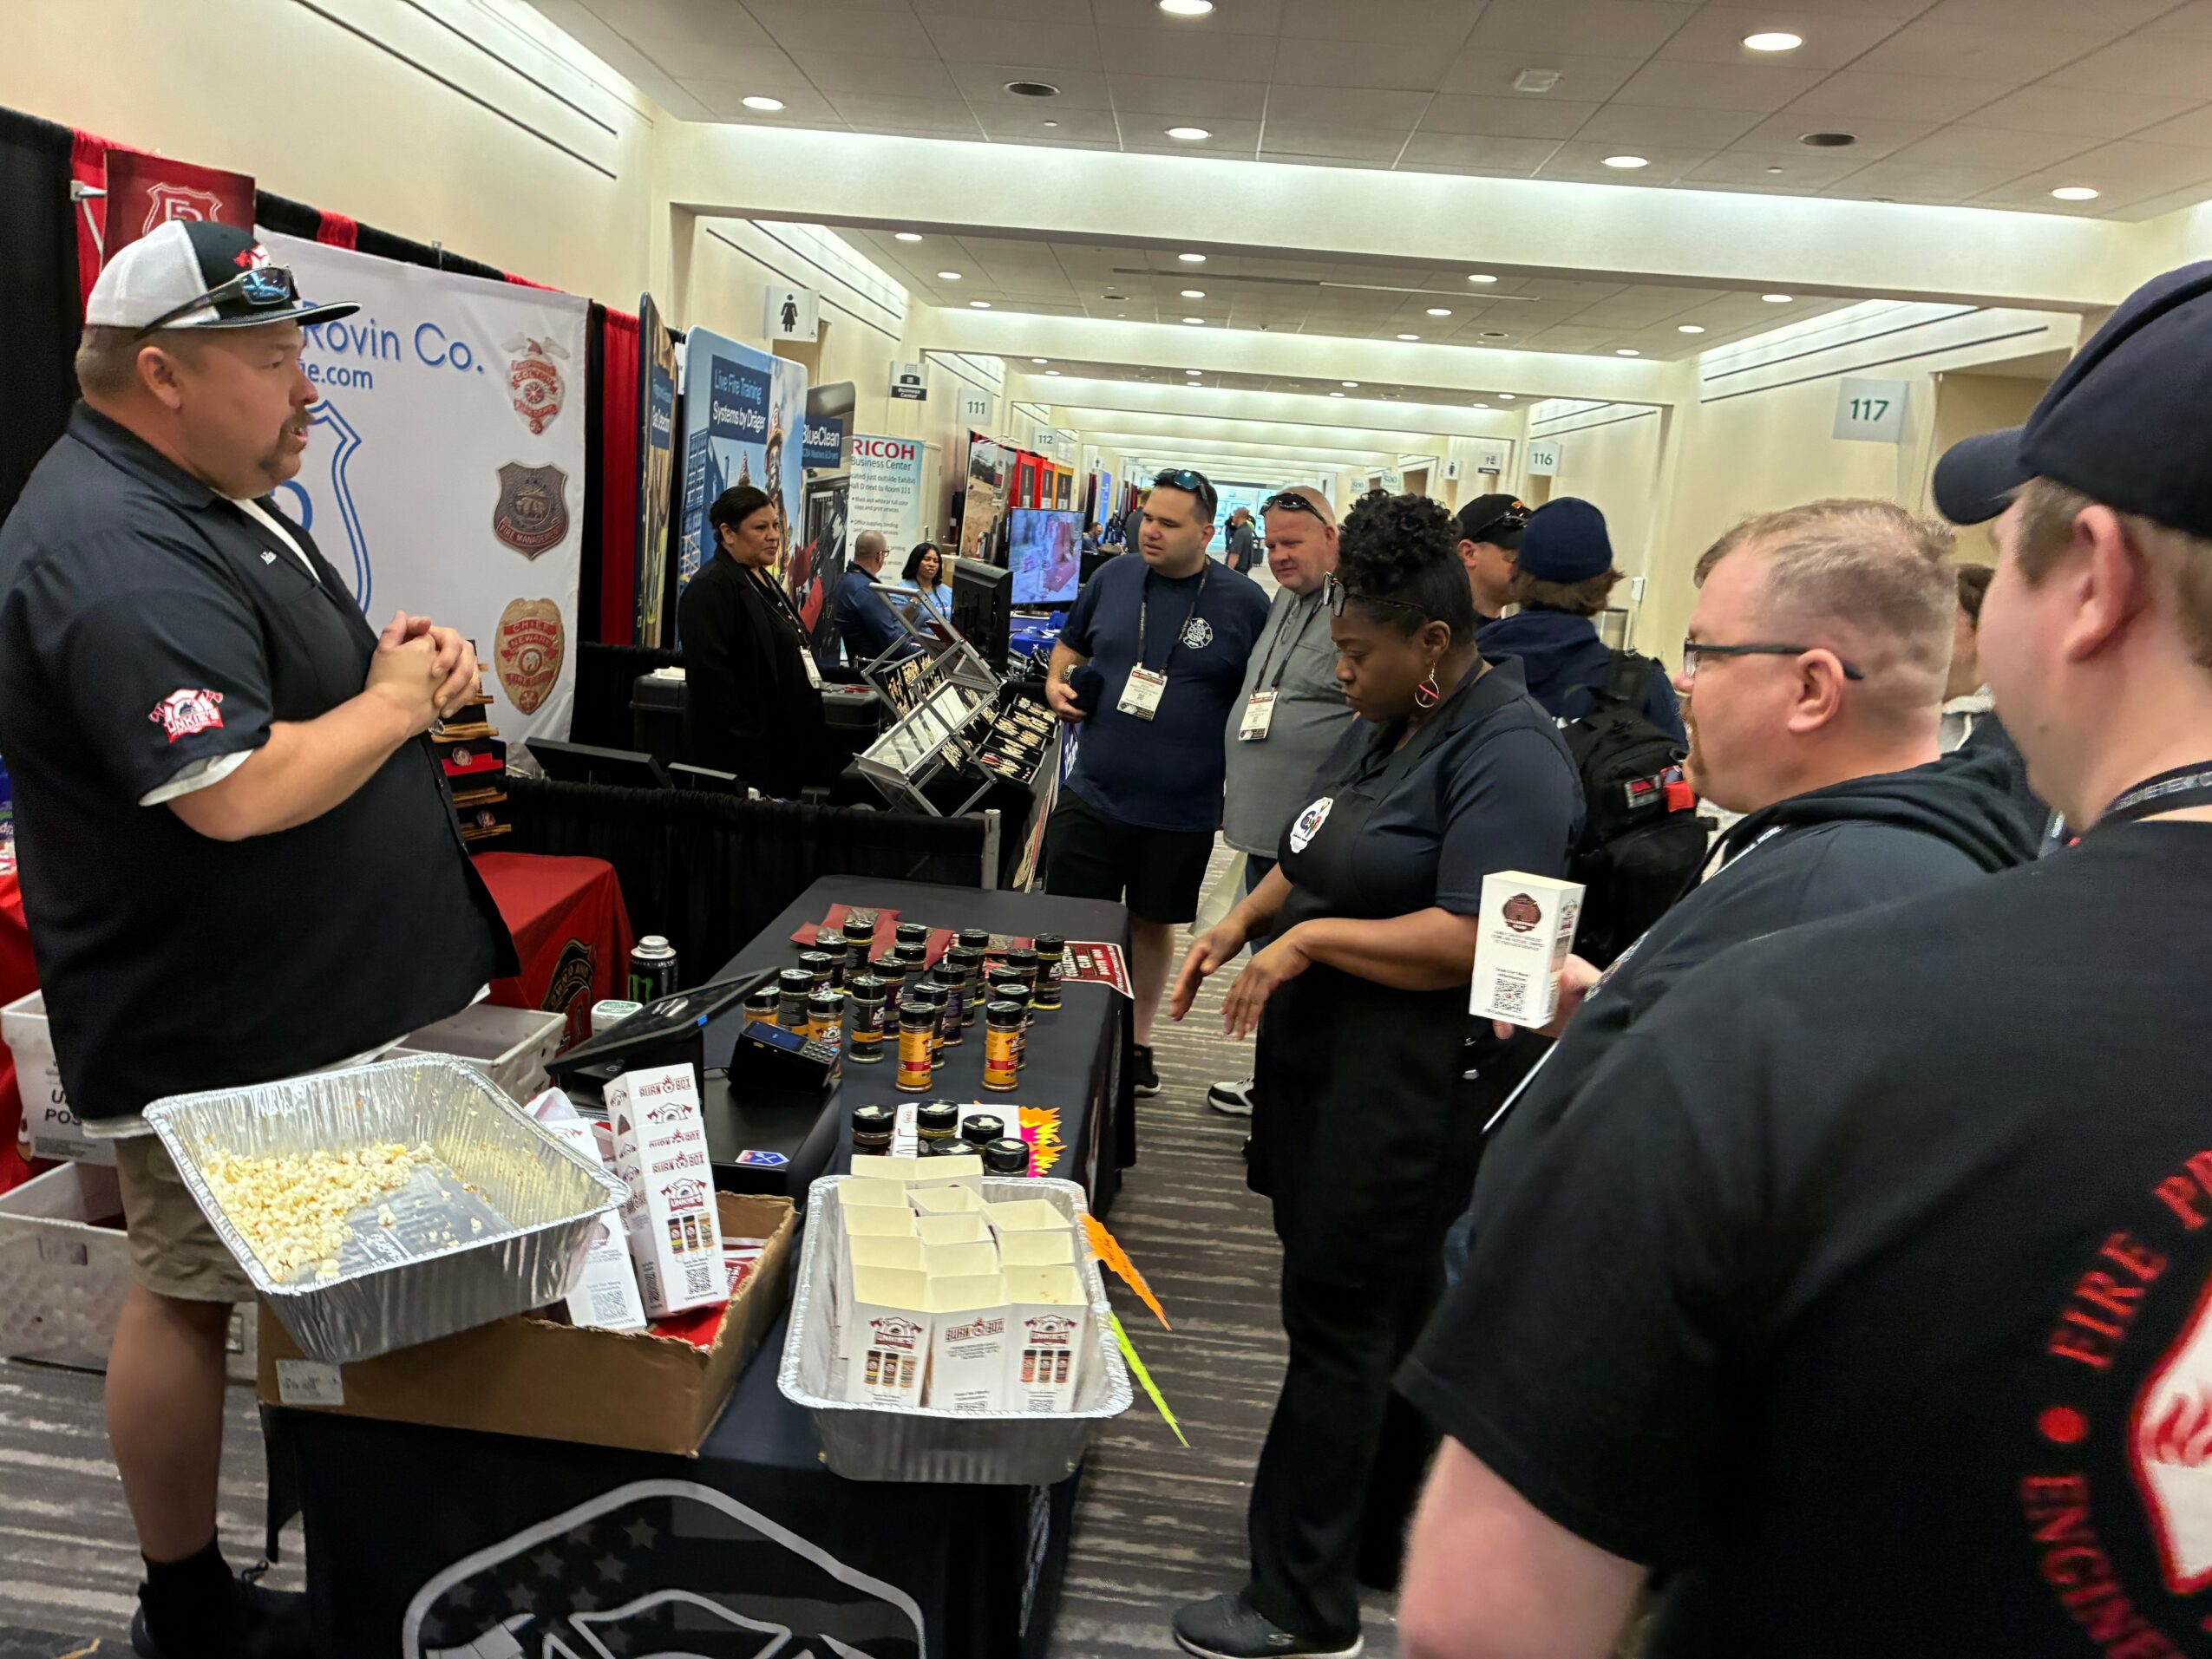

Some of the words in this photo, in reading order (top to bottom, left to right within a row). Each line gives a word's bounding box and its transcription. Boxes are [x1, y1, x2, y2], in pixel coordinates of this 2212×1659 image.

[414, 322, 485, 374] Co.
[714, 369, 728, 391] Live
[728, 374, 740, 395] Fire
[740, 377, 762, 405] Training
[897, 387, 921, 395] Business
[967, 401, 986, 415] 111
[1849, 398, 1890, 421] 117
[712, 401, 738, 425] Systems
[739, 408, 747, 430] by
[747, 408, 766, 434] Dräger
[1037, 434, 1053, 445] 112
[852, 439, 915, 460] RICOH
[851, 456, 885, 468] Business
[886, 460, 912, 471] Center
[1534, 452, 1554, 466] 116
[878, 474, 897, 483] outside
[898, 476, 916, 485] Exhibit
[885, 485, 900, 493] Room
[499, 524, 514, 538] FIRE
[513, 619, 550, 632] CHIEF
[510, 634, 551, 648] NEWARK
[638, 1085, 662, 1098] BURN
[676, 1078, 692, 1090] BOX
[651, 1160, 675, 1174] BURN
[688, 1153, 705, 1166] BOX
[2047, 1231, 2168, 1370] FIRE
[944, 1326, 971, 1342] BURN
